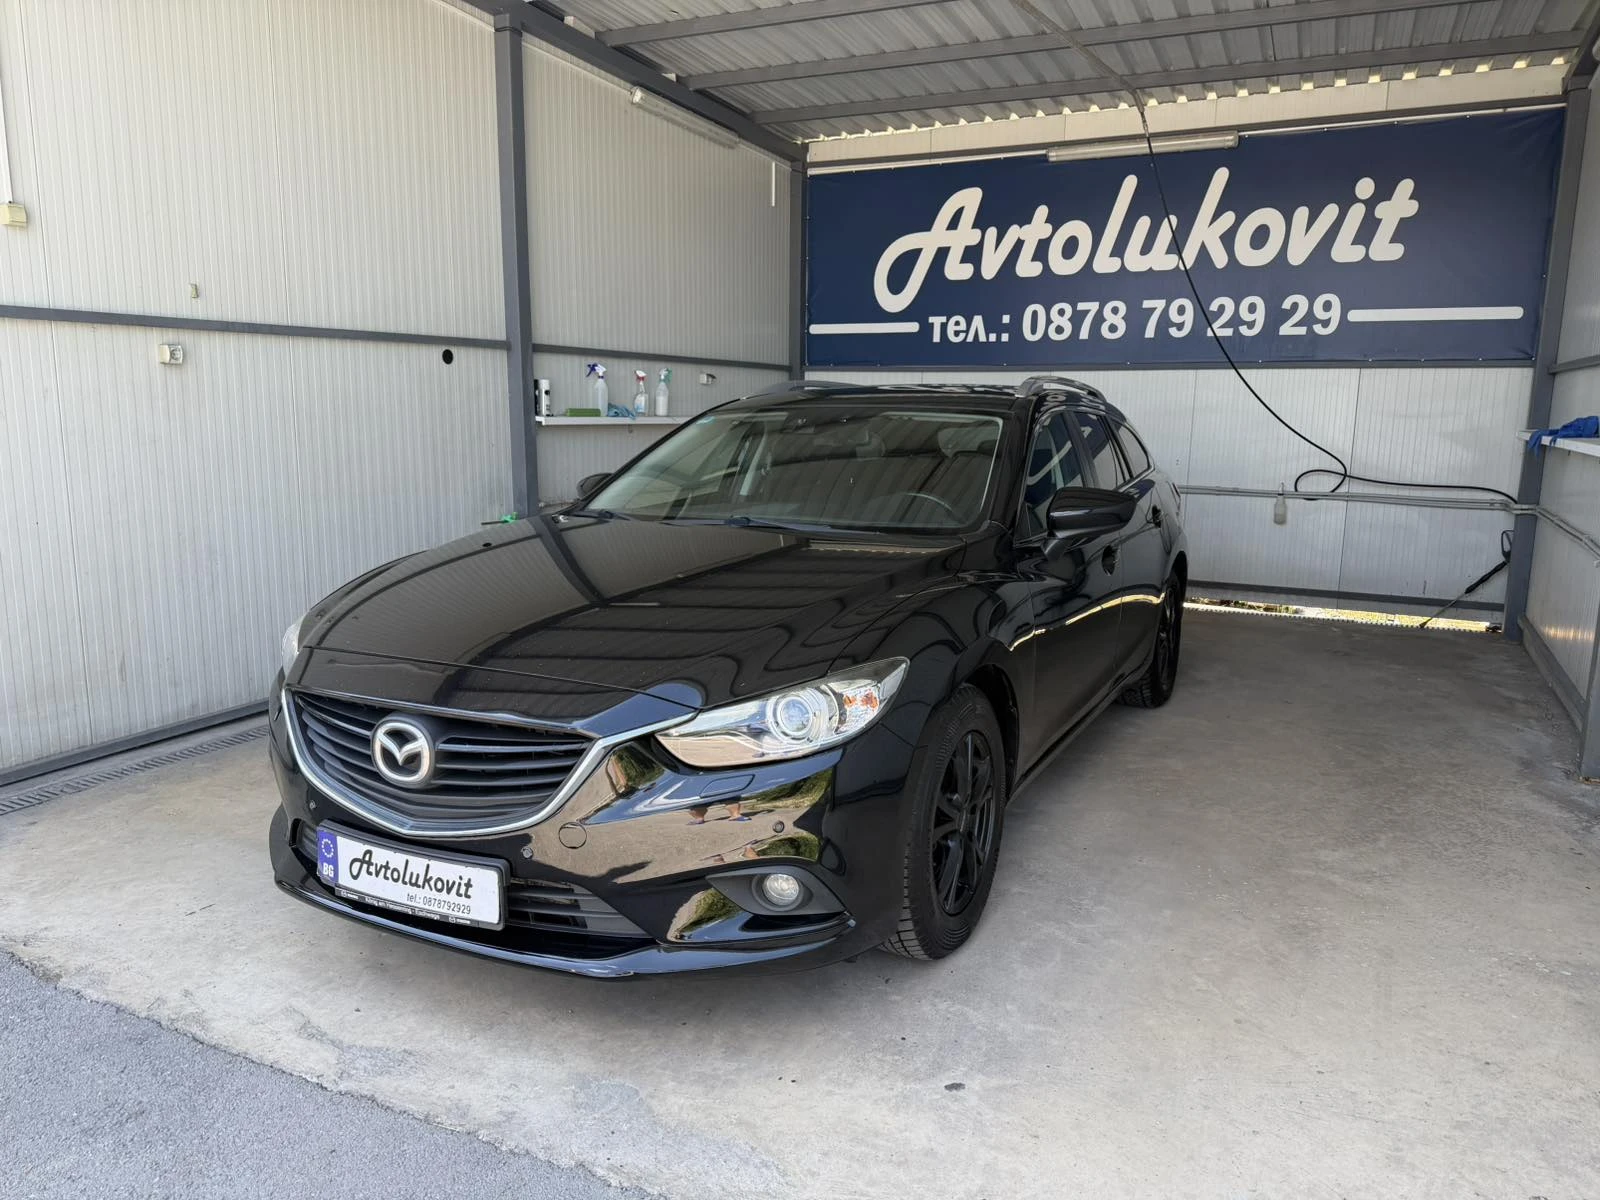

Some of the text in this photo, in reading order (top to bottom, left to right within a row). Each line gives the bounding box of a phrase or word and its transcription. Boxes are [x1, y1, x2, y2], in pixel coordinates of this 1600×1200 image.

[873, 166, 1420, 313] Avtolukovit
[928, 293, 1342, 343] тел.: 0878 79 29 29
[323, 862, 334, 877] BG
[350, 849, 473, 899] Avtolukovit
[407, 893, 421, 904] tel.:
[422, 895, 471, 915] 0878792929
